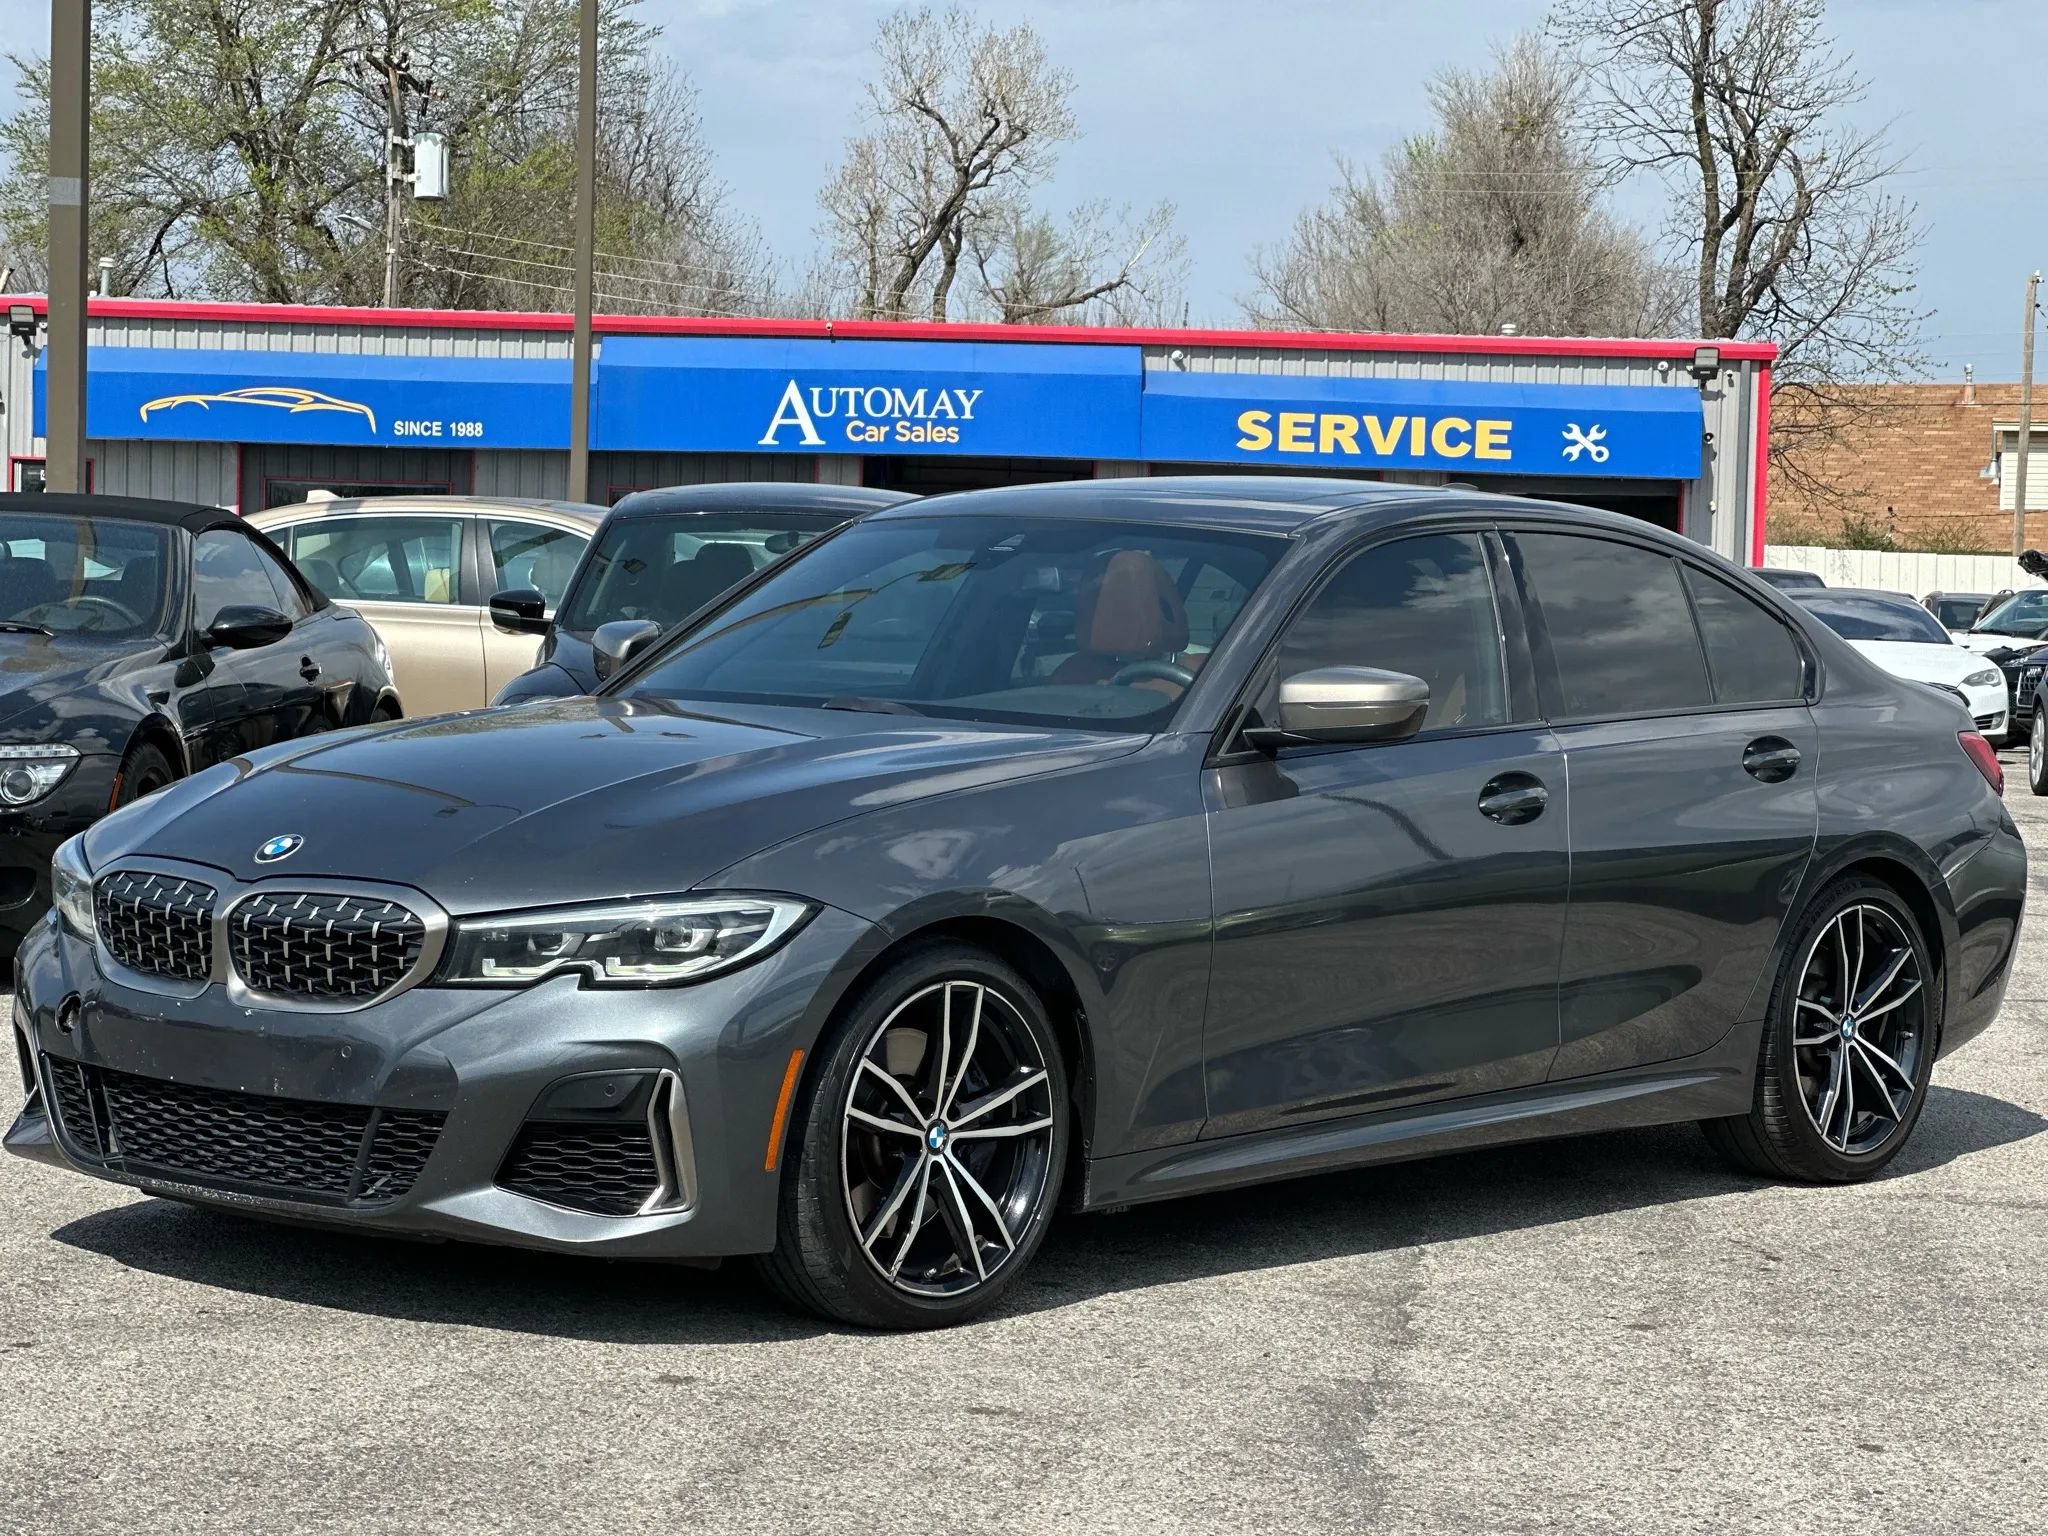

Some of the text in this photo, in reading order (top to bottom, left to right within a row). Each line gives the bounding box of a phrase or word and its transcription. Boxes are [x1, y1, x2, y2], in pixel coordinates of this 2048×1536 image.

[393, 420, 484, 437] SINCE 1988
[757, 379, 984, 445] AUTOMAY
[846, 420, 960, 444] Car Sales
[1236, 410, 1513, 460] SERVICE
